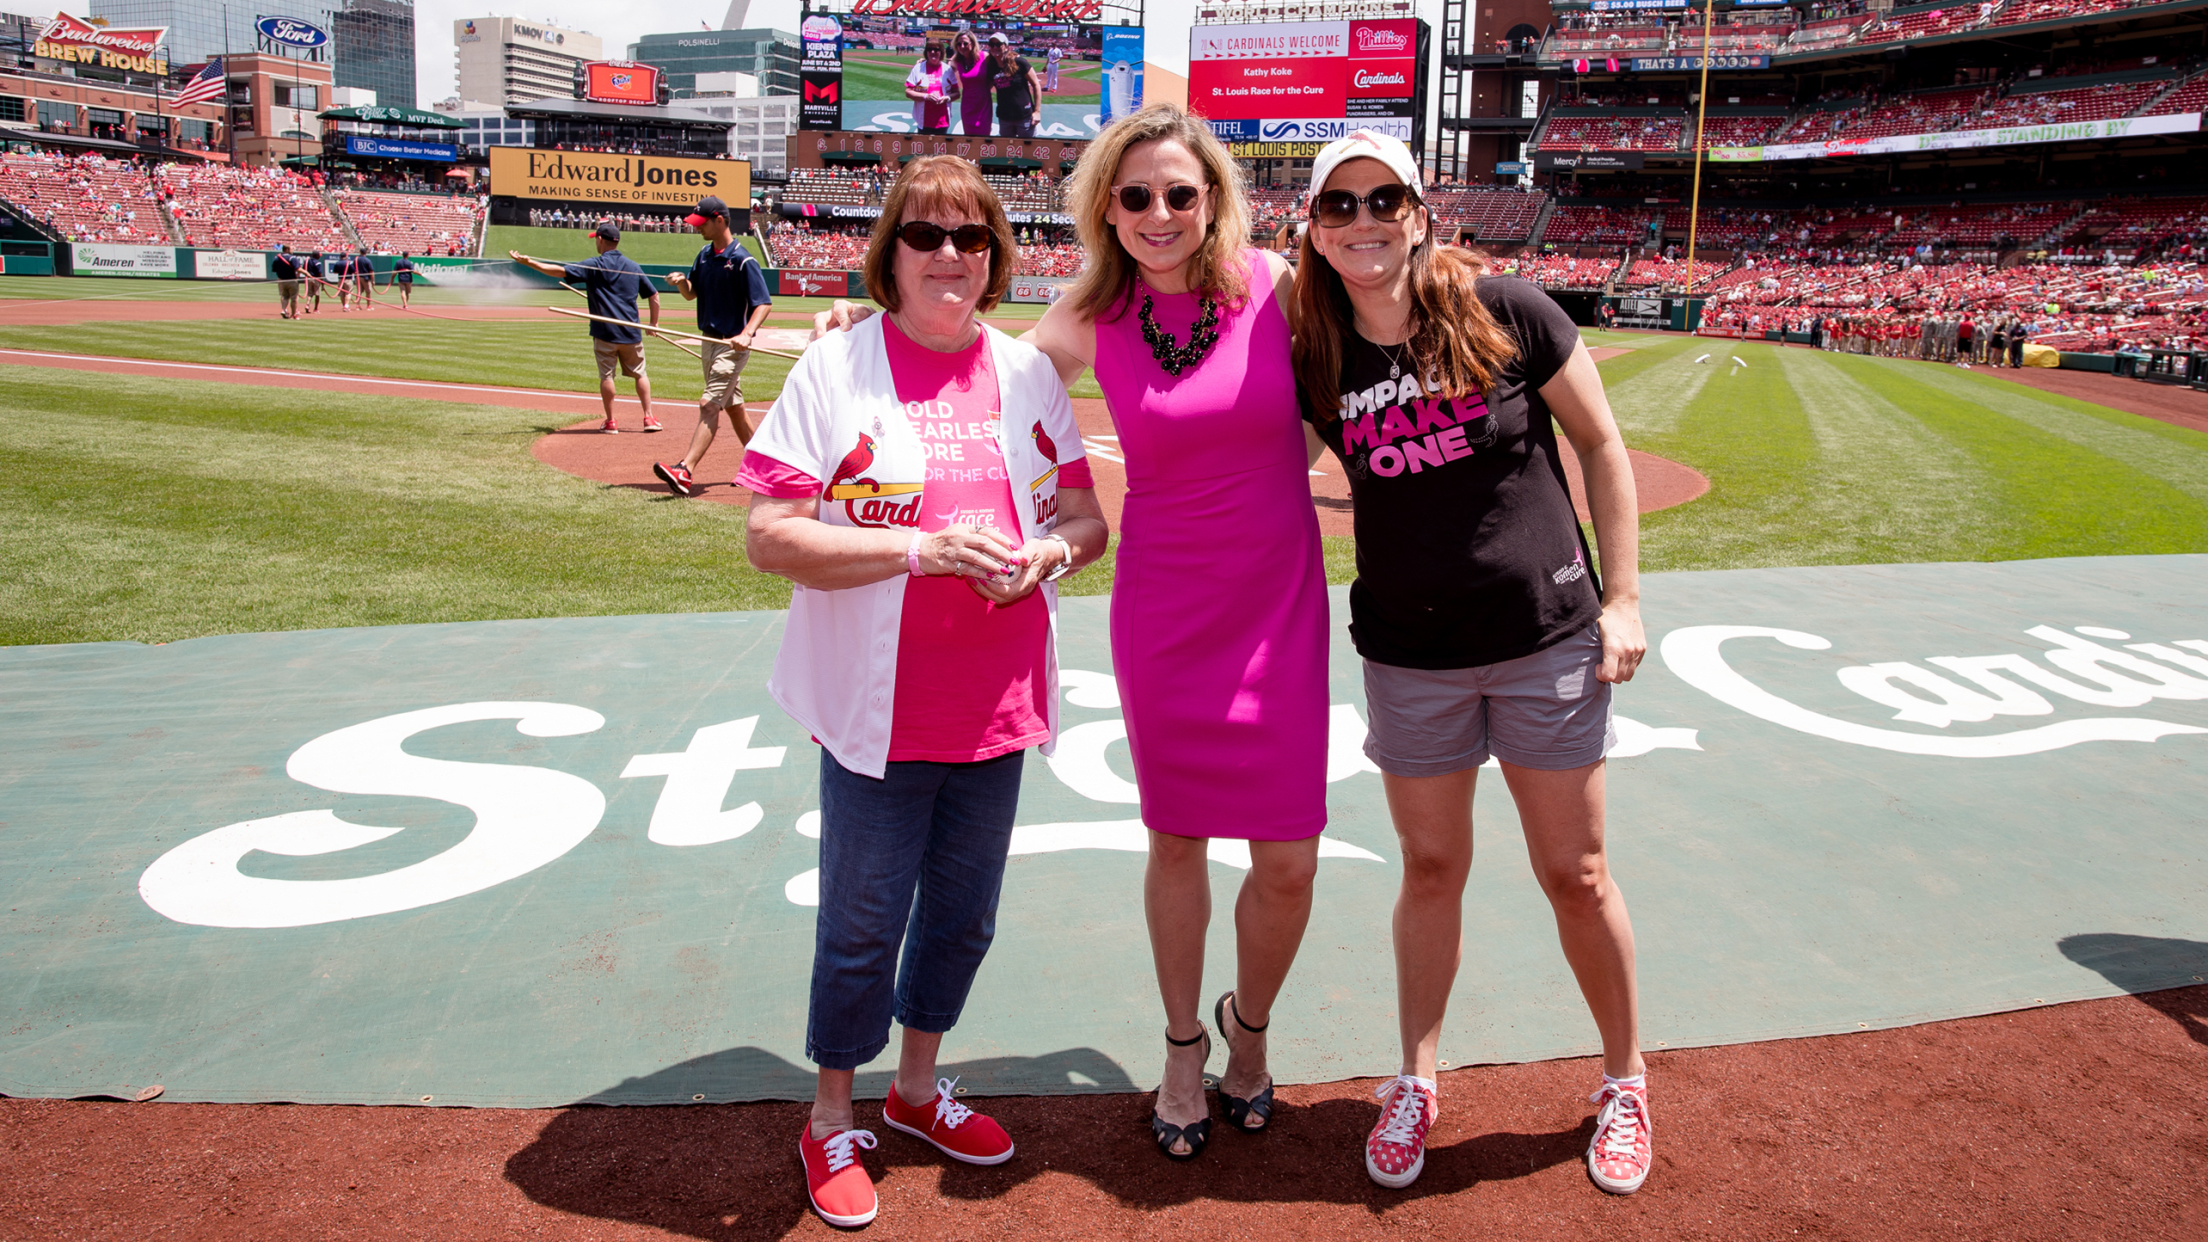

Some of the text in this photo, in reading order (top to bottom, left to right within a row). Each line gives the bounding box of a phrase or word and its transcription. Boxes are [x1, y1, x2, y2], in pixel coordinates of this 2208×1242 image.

[1215, 2, 1394, 19] WORLD CHAMPIONS
[40, 20, 166, 51] Budweiser
[273, 20, 315, 44] Ford
[514, 24, 543, 39] KMOV
[678, 38, 720, 47] POLSINELLI
[1228, 36, 1284, 50] CARDINALS
[1289, 35, 1341, 48] WELCOME
[1356, 27, 1408, 50] Phillies
[806, 43, 837, 51] KIENER
[35, 40, 168, 75] BREW HOUSE
[1638, 58, 1675, 69] THAT'S
[1680, 59, 1688, 68] A
[1244, 67, 1292, 77] Kathy Koke
[1354, 69, 1405, 88] Cardinals
[1212, 86, 1324, 96] St. Louis Race for the Cure
[407, 114, 445, 125] MVP Deck
[1997, 123, 2097, 143] STANDING
[2106, 120, 2132, 136] BY
[357, 141, 451, 156] BJC Choose Better Medicine
[839, 139, 846, 151] 1
[855, 140, 864, 152] 2
[873, 140, 882, 152] 6
[892, 141, 900, 153] 9
[911, 142, 924, 154] 10
[934, 143, 947, 155] 14
[957, 143, 970, 156] 17
[980, 144, 996, 157] 20
[1006, 145, 1022, 158] 24
[1234, 142, 1249, 156] ST.
[1252, 142, 1286, 156] LOUIS
[1033, 146, 1050, 159] 42
[1059, 147, 1076, 160] 45
[1554, 157, 1577, 167] Mercy
[527, 152, 718, 188] Edward Jones
[528, 185, 714, 202] MAKING SENSE OF INVESTIN
[1007, 213, 1031, 223] utes
[1034, 214, 1050, 224] 24
[92, 257, 134, 267] Ameren
[414, 262, 468, 276] National
[785, 272, 842, 282] Bank of America
[1018, 288, 1029, 296] 66
[1620, 299, 1637, 310] ALTEC
[906, 400, 953, 418] OLD
[1342, 382, 1489, 456] MAKE
[910, 421, 994, 439] EARLES
[921, 442, 964, 461] ORE
[1369, 425, 1474, 478] ONE
[925, 467, 946, 481] OR
[949, 467, 983, 482] THE
[958, 513, 995, 527] race
[1569, 567, 1585, 581] cure
